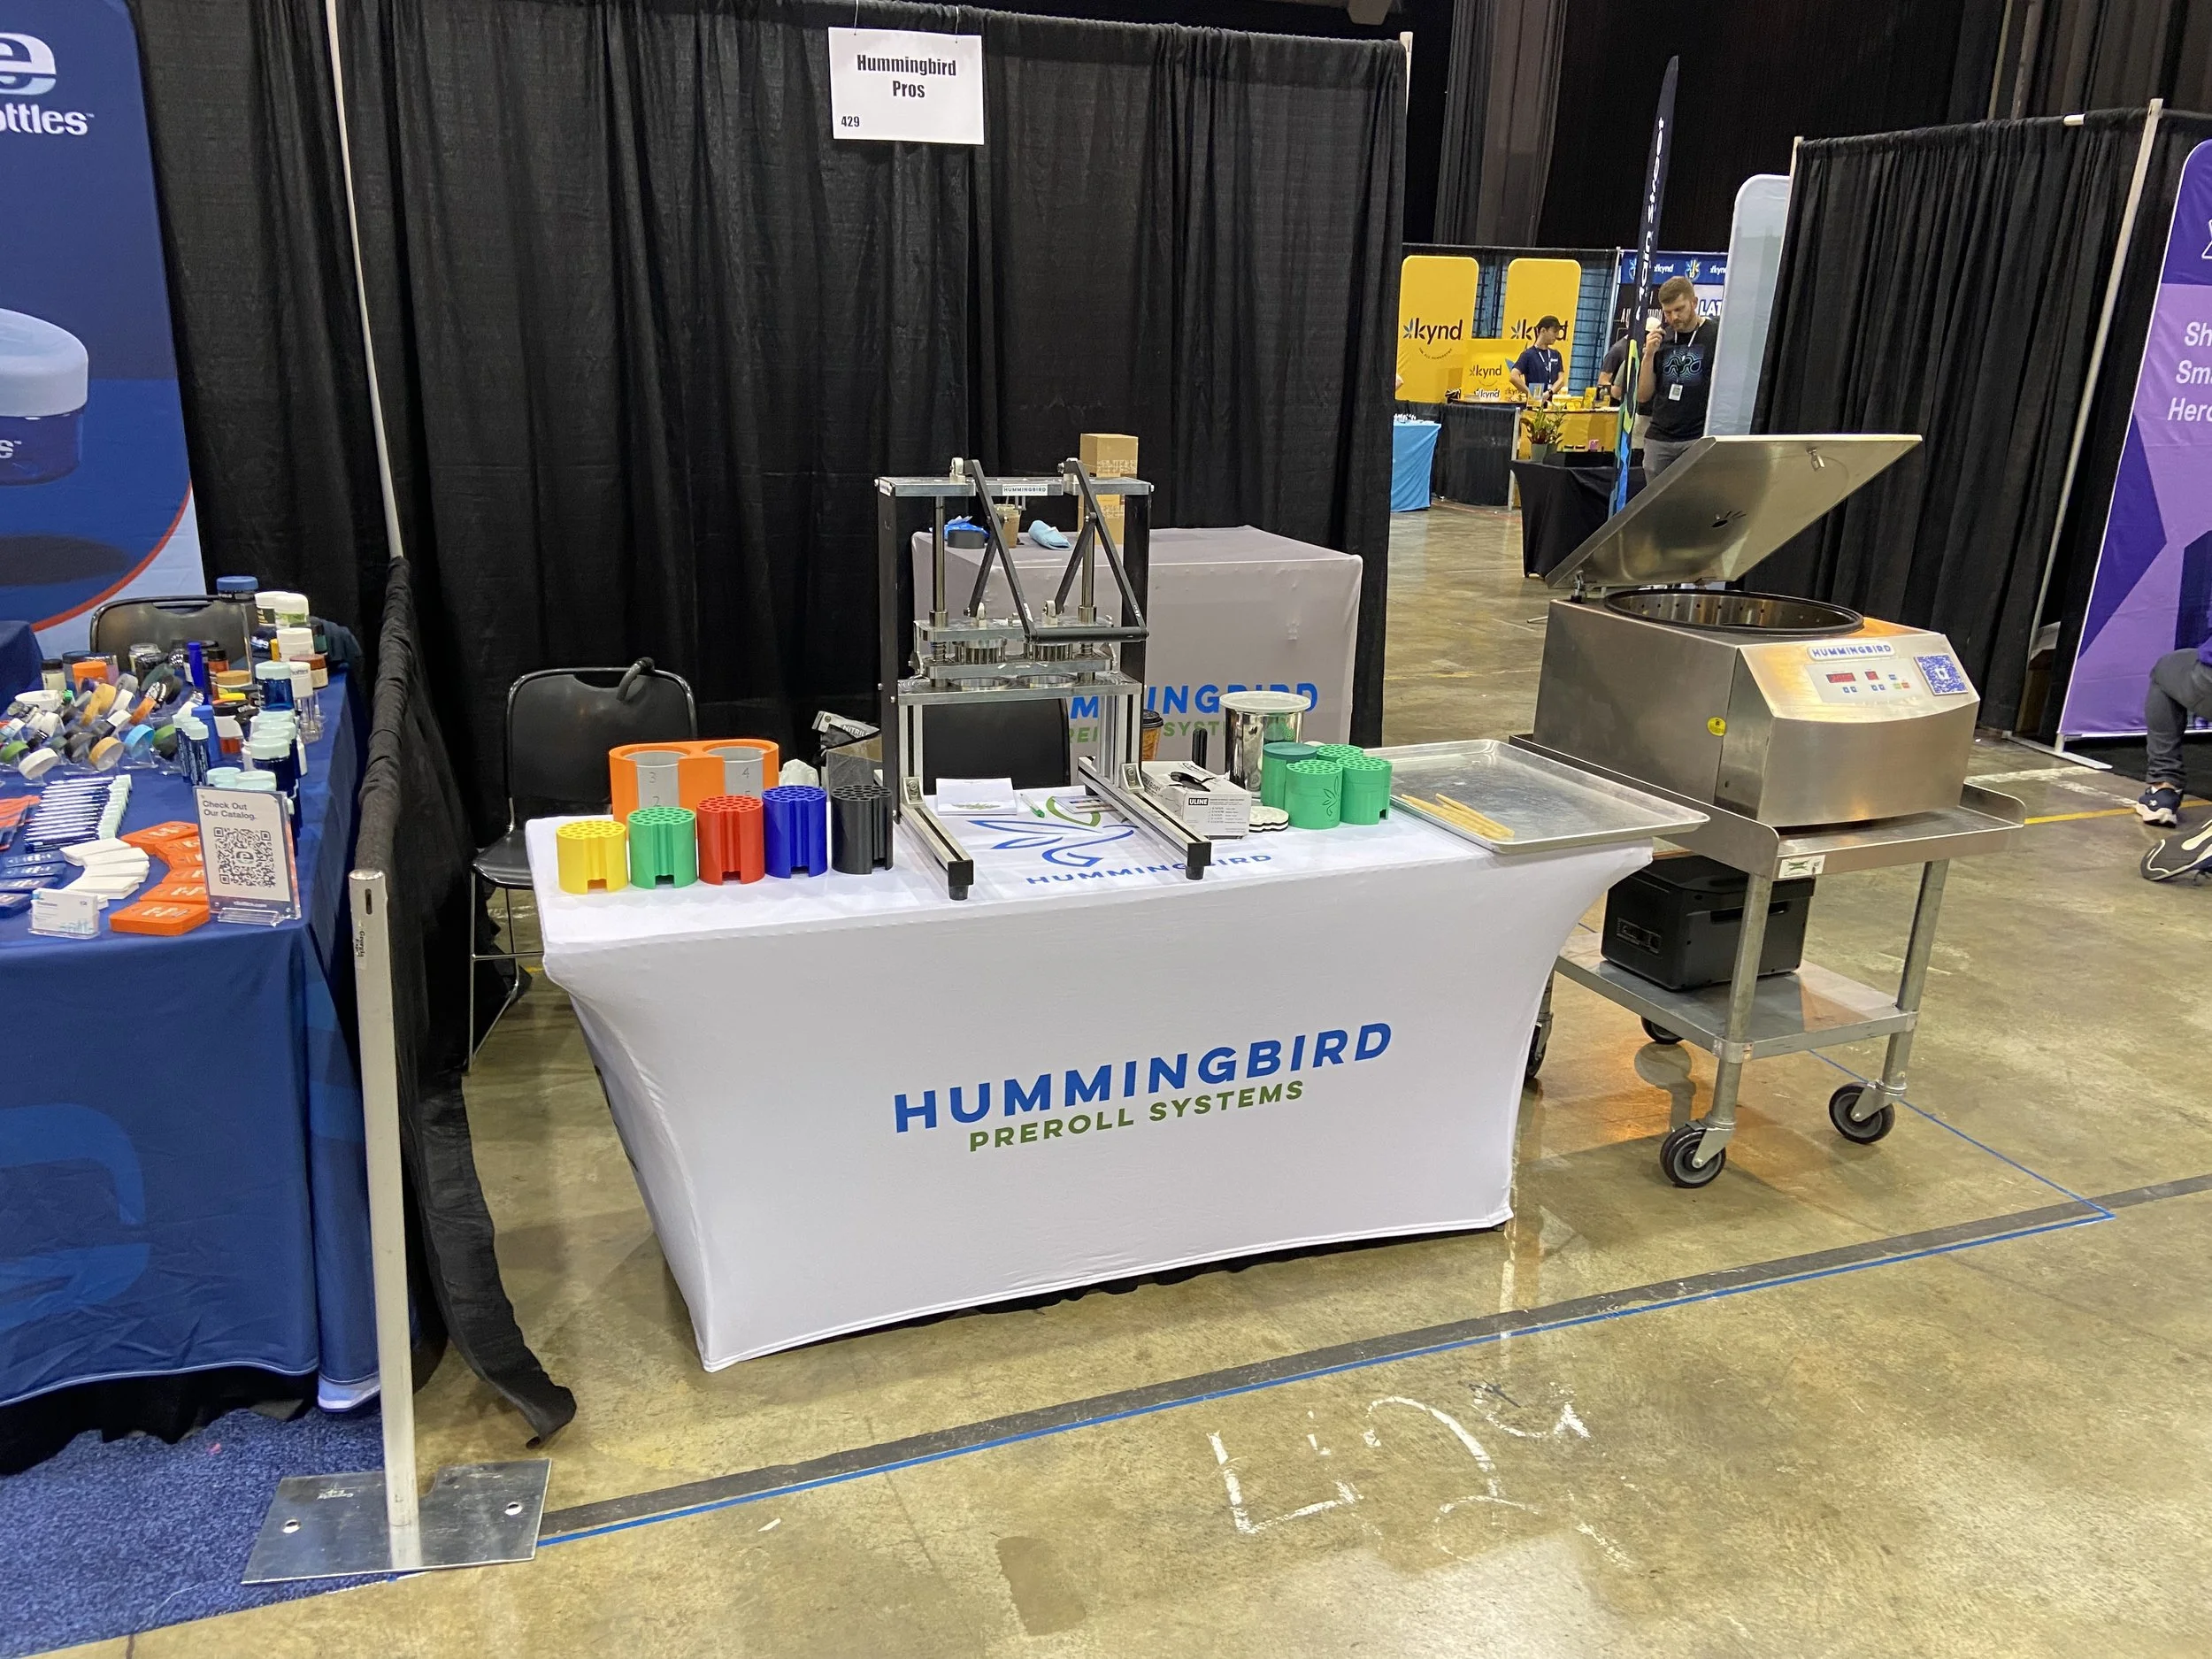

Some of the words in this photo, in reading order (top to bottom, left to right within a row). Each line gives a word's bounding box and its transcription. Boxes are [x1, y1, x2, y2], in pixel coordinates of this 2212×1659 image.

[856, 54, 956, 76] Hummingbird
[892, 81, 926, 98] Pros
[841, 116, 860, 127] 429
[1713, 265, 1727, 275] kyn
[1414, 318, 1463, 345] kynd
[1522, 319, 1569, 343] kyd
[1476, 365, 1502, 379] kynd
[2176, 359, 2212, 384] Sm
[1812, 644, 1892, 657] HUMMINGBIRD
[649, 772, 657, 783] 3
[741, 767, 750, 779] 4
[203, 800, 229, 809] Check
[1025, 855, 1272, 885] HUMMINGIRD
[895, 1022, 1392, 1133] HUMMINGBIRD
[971, 1108, 1135, 1152] PREROLL
[1148, 1079, 1303, 1122] SYSTEMS
